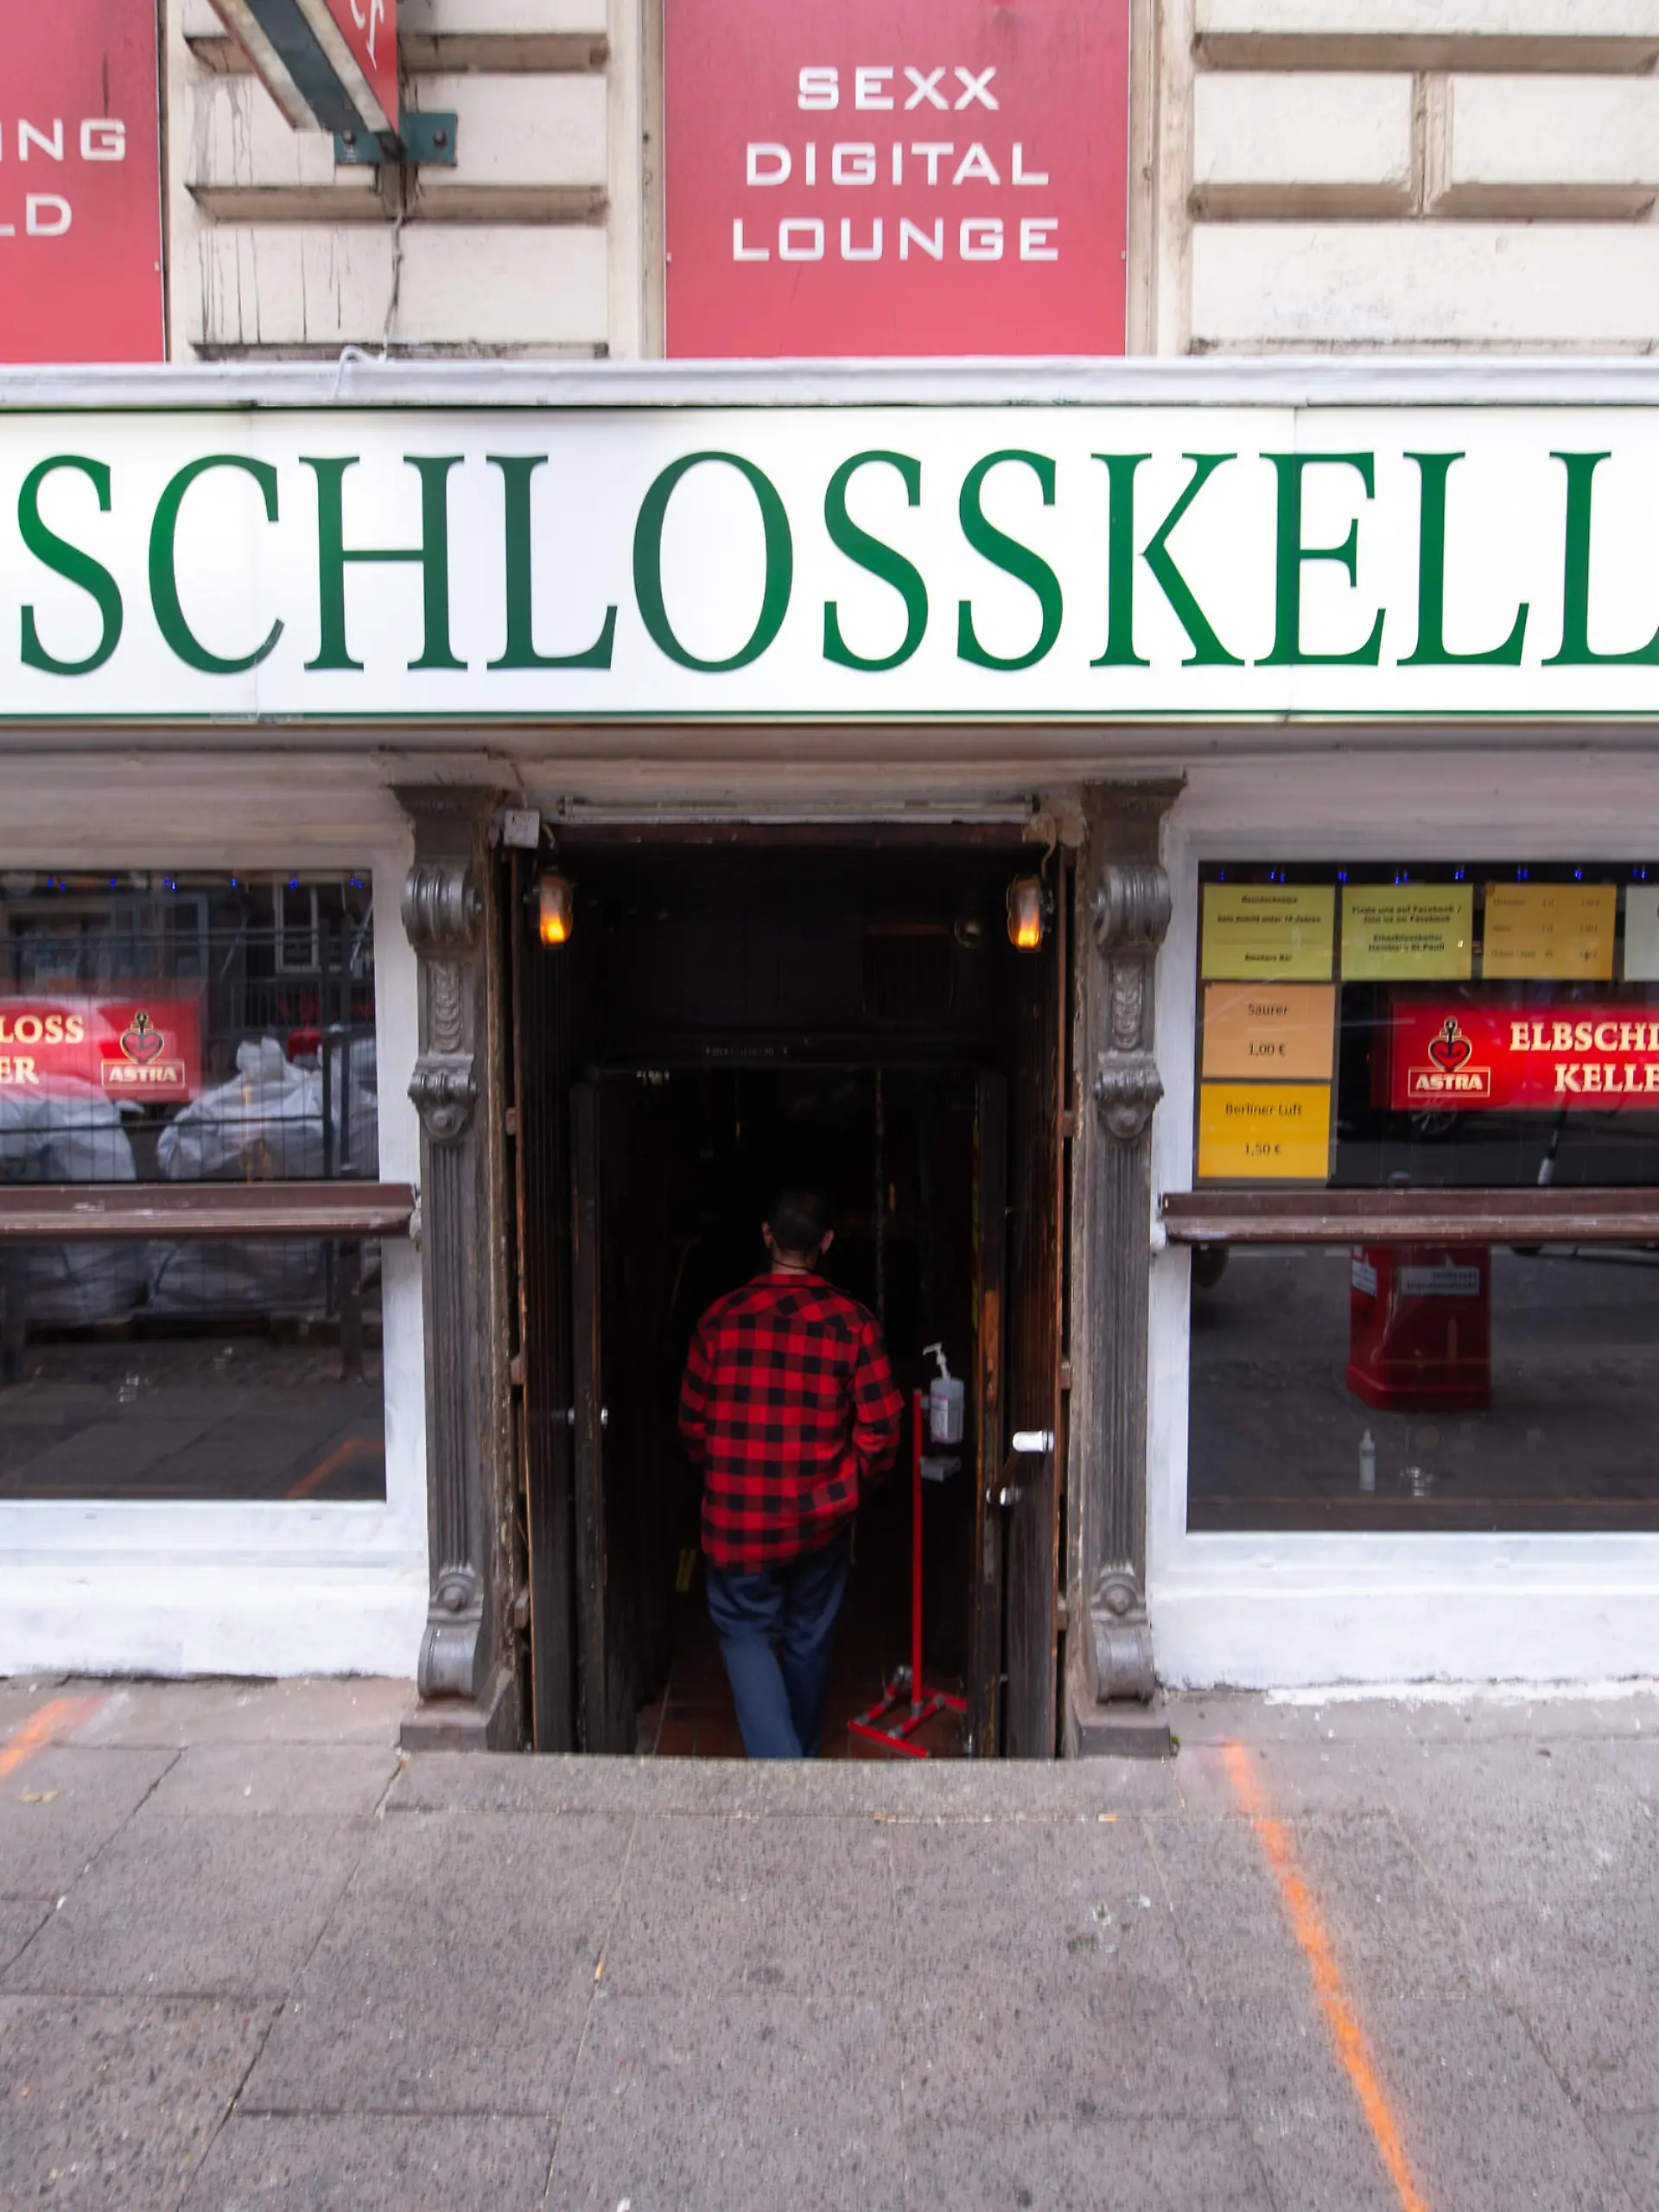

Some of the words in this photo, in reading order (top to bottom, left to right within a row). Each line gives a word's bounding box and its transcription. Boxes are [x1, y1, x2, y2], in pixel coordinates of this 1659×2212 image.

[798, 66, 999, 110] SEXX
[0, 118, 125, 162] NG
[747, 142, 1049, 186] DIGITAL
[733, 218, 1059, 261] LOUNGE
[17, 448, 1659, 676] SCHLOSSKELL
[1248, 1004, 1288, 1016] Saurer
[1249, 1043, 1274, 1057] 1,00
[1278, 1044, 1286, 1057] €
[109, 1066, 178, 1083] ASTRA
[1415, 1073, 1484, 1091] ASTRA
[1225, 1103, 1274, 1116] Berliner
[1278, 1103, 1302, 1116] Luft
[1245, 1143, 1270, 1157] 1,50
[1274, 1144, 1281, 1156] €
